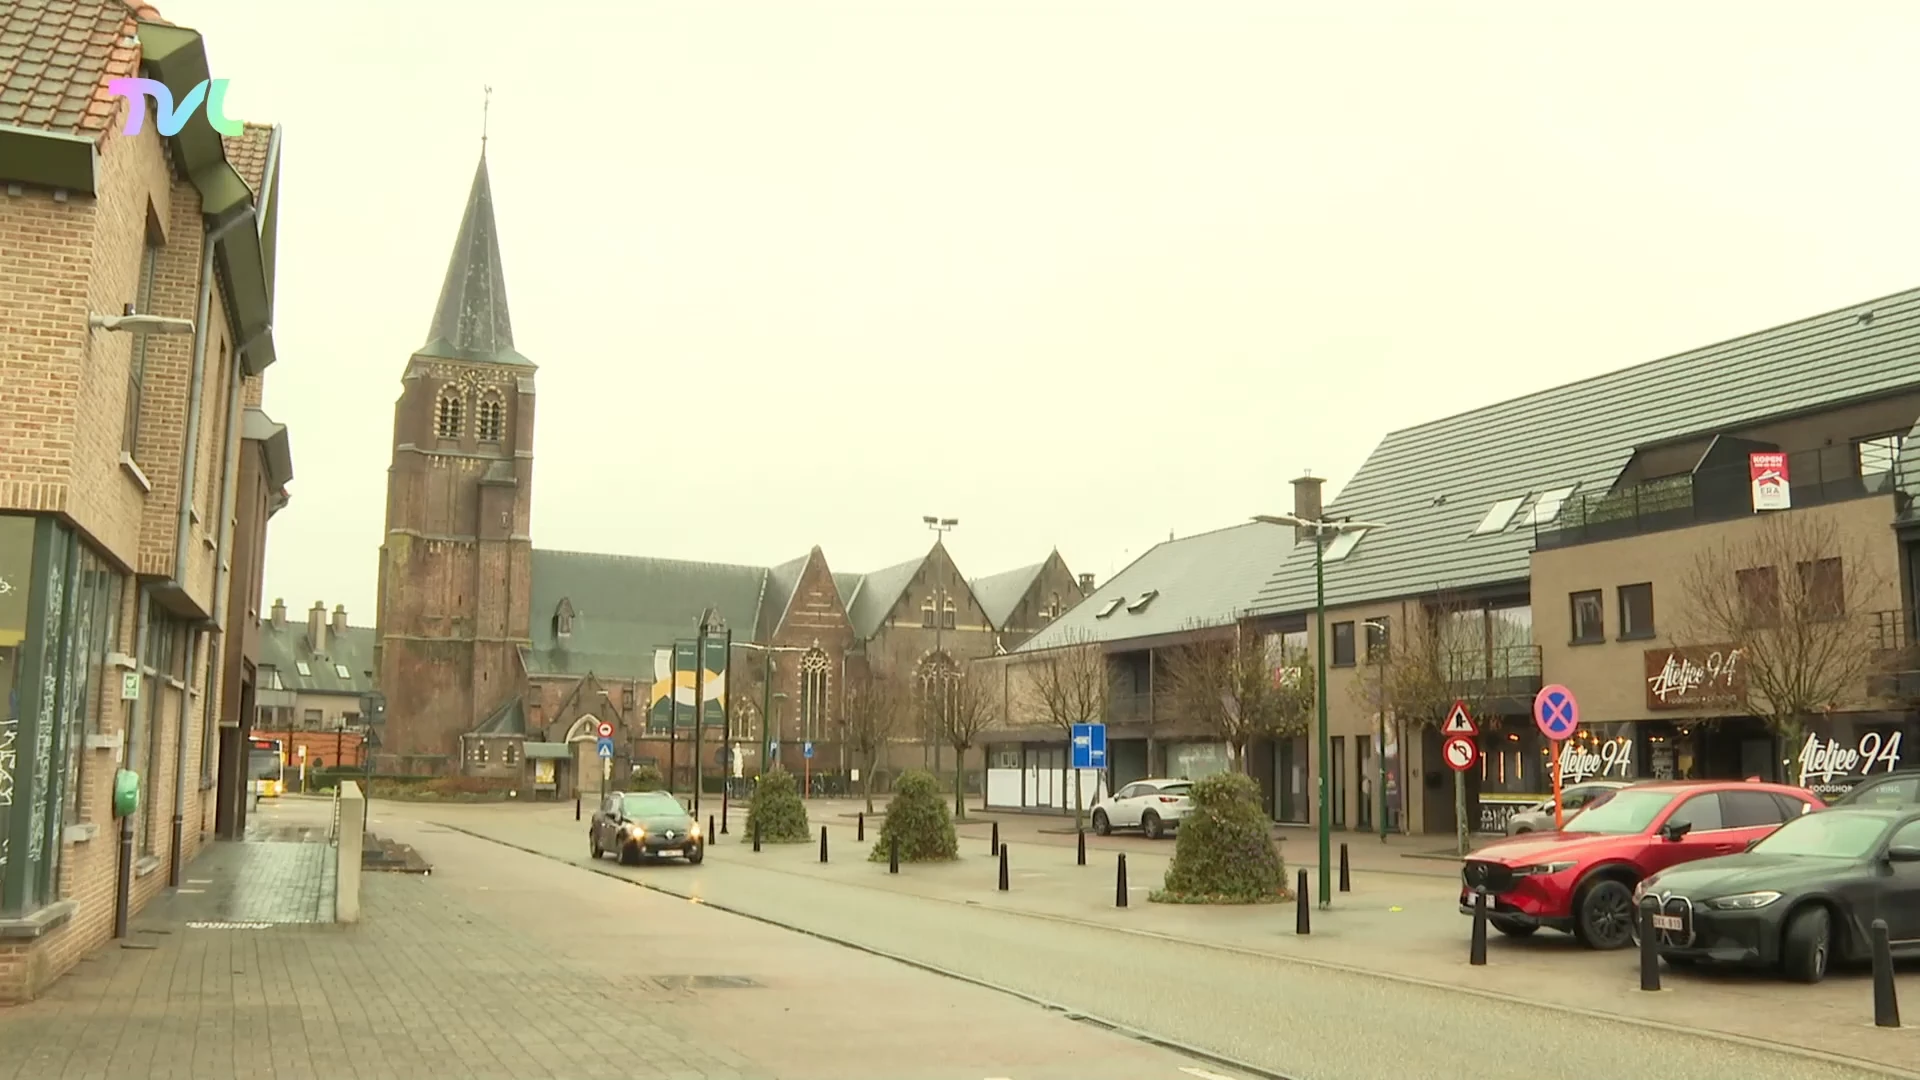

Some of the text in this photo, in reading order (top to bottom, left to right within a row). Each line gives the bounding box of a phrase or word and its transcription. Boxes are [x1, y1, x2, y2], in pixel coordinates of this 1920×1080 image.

[1601, 739, 1632, 777] 94
[1798, 731, 1902, 788] Ateljee 94
